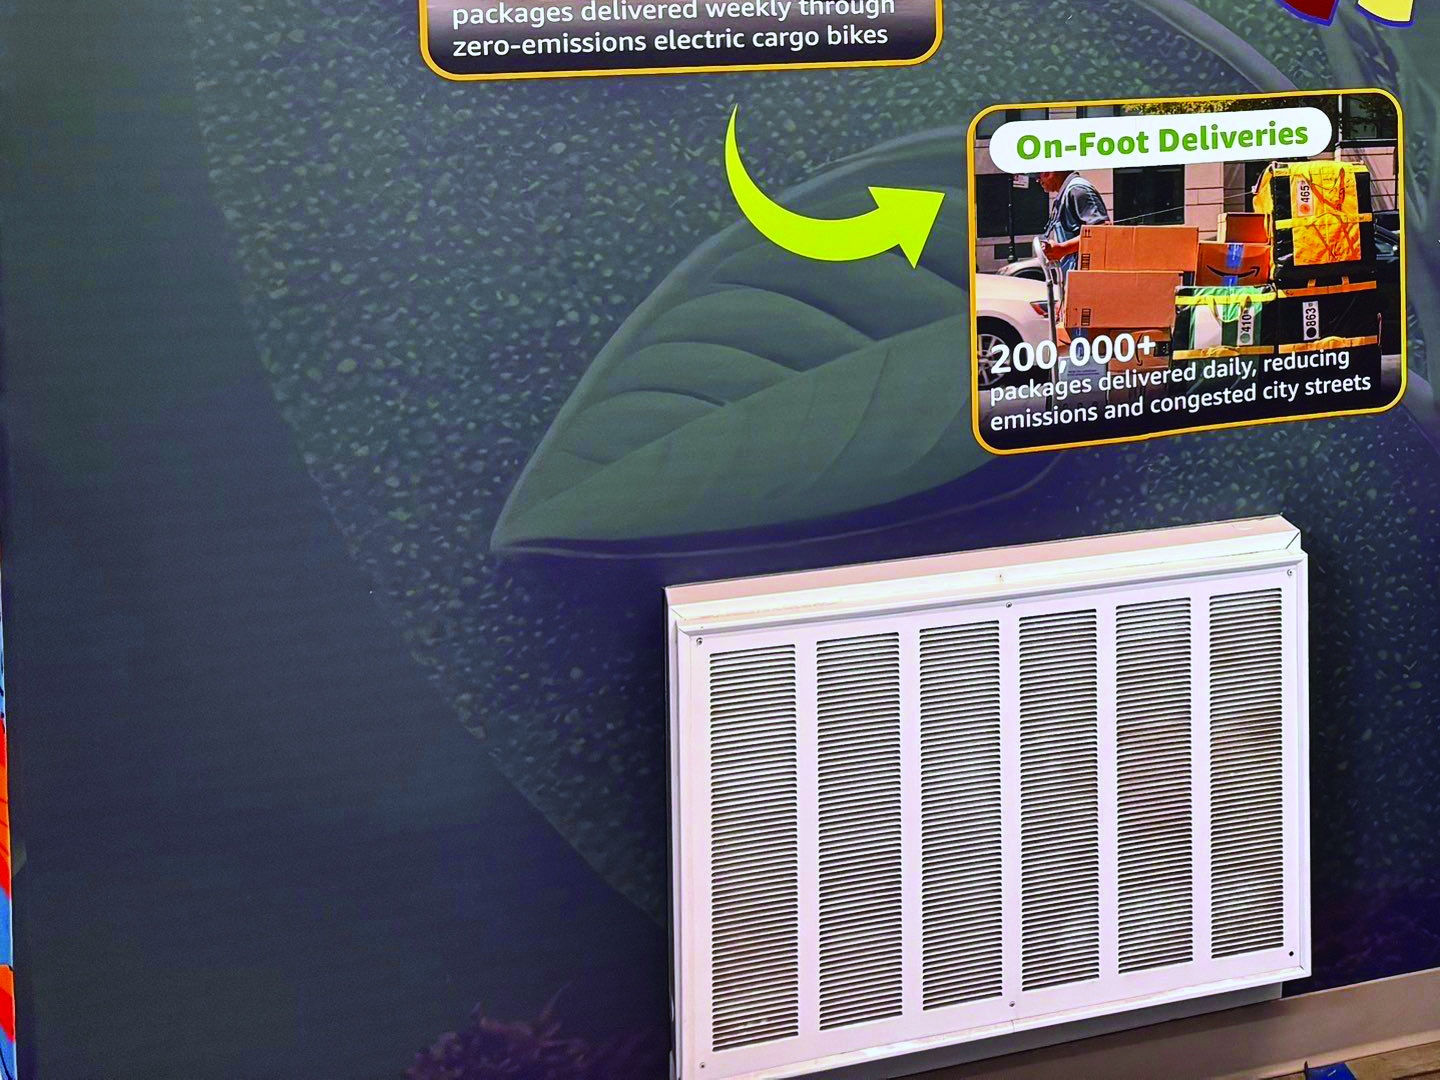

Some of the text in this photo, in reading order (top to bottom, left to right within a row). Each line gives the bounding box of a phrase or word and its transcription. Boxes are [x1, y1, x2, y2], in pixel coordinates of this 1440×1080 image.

[452, 0, 574, 29] packages
[452, 24, 889, 58] zero-emissions electric cargo bikes
[1016, 120, 1309, 160] On-Foot Deliveries
[1300, 185, 1311, 203] 465
[1241, 314, 1252, 332] 410
[1306, 307, 1317, 326] 863
[991, 333, 1156, 375] 200,000+
[990, 348, 1350, 406] packages delivered daily, reducing
[990, 375, 1372, 431] emissions and congested city streets
